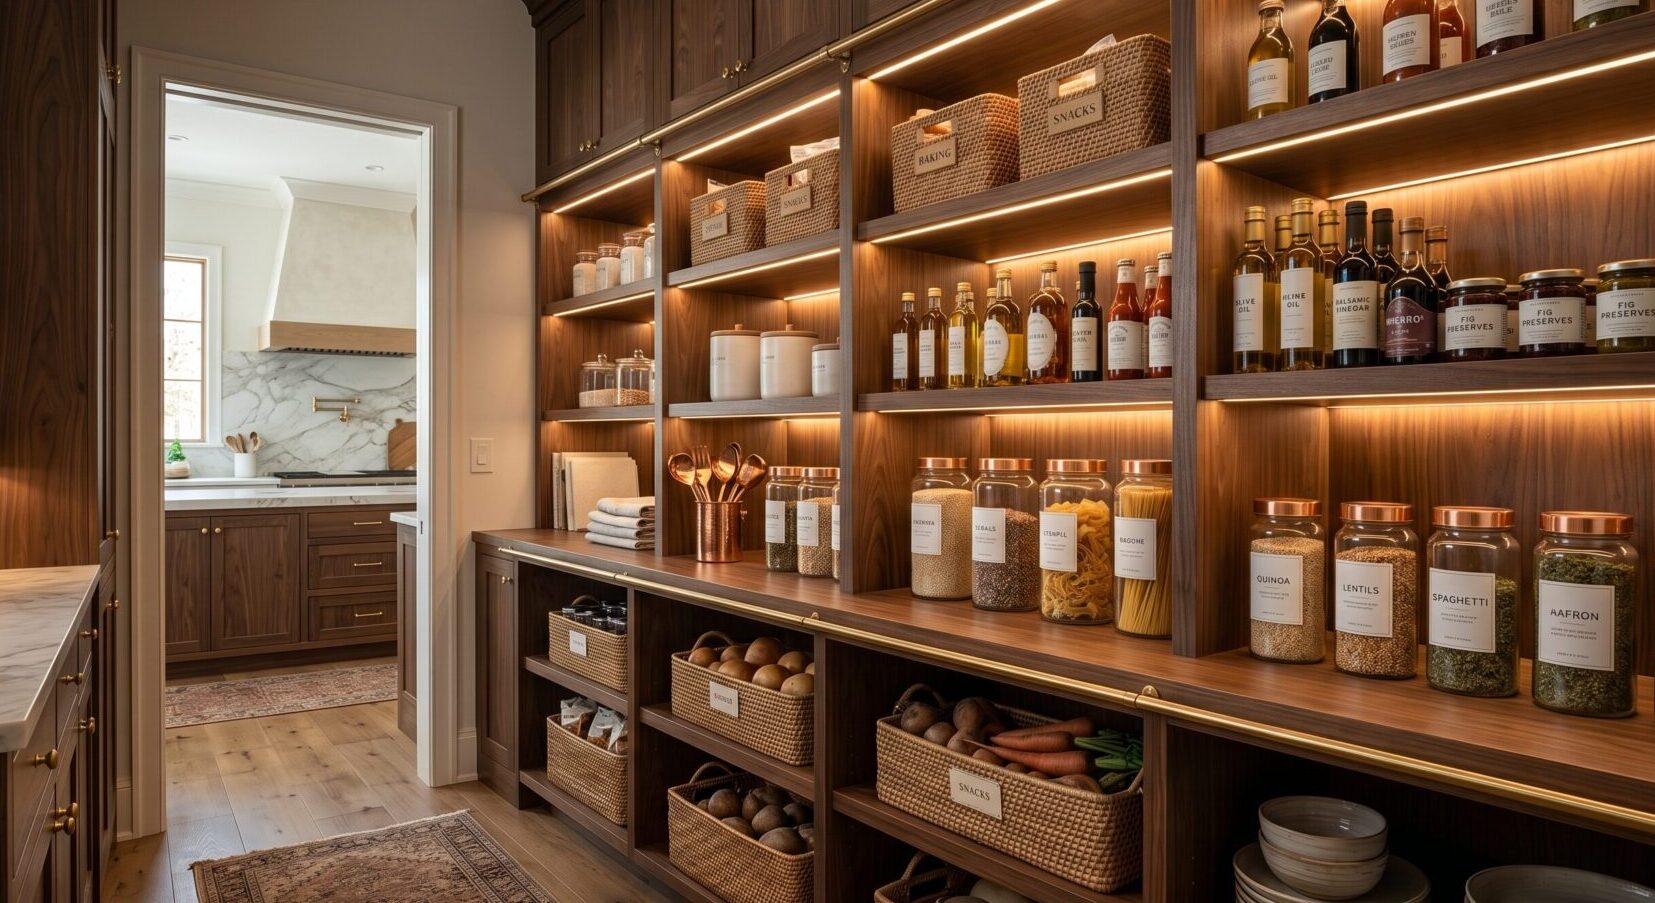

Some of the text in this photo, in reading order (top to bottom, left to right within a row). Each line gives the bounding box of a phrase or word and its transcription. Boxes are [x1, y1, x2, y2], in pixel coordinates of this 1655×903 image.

[1053, 102, 1097, 125] SNACKS
[918, 149, 952, 166] BAKING
[1335, 296, 1371, 306] BALSAMIC
[1618, 301, 1635, 309] FIG
[1601, 308, 1655, 319] PRESERVES
[1522, 317, 1573, 326] PRESERVES
[1256, 575, 1291, 585] QUINOA
[1342, 584, 1380, 595] LENTILS
[1432, 593, 1489, 607] SPAGHETTI
[1550, 608, 1599, 621] AAFRON
[959, 783, 990, 800] SNACKS
